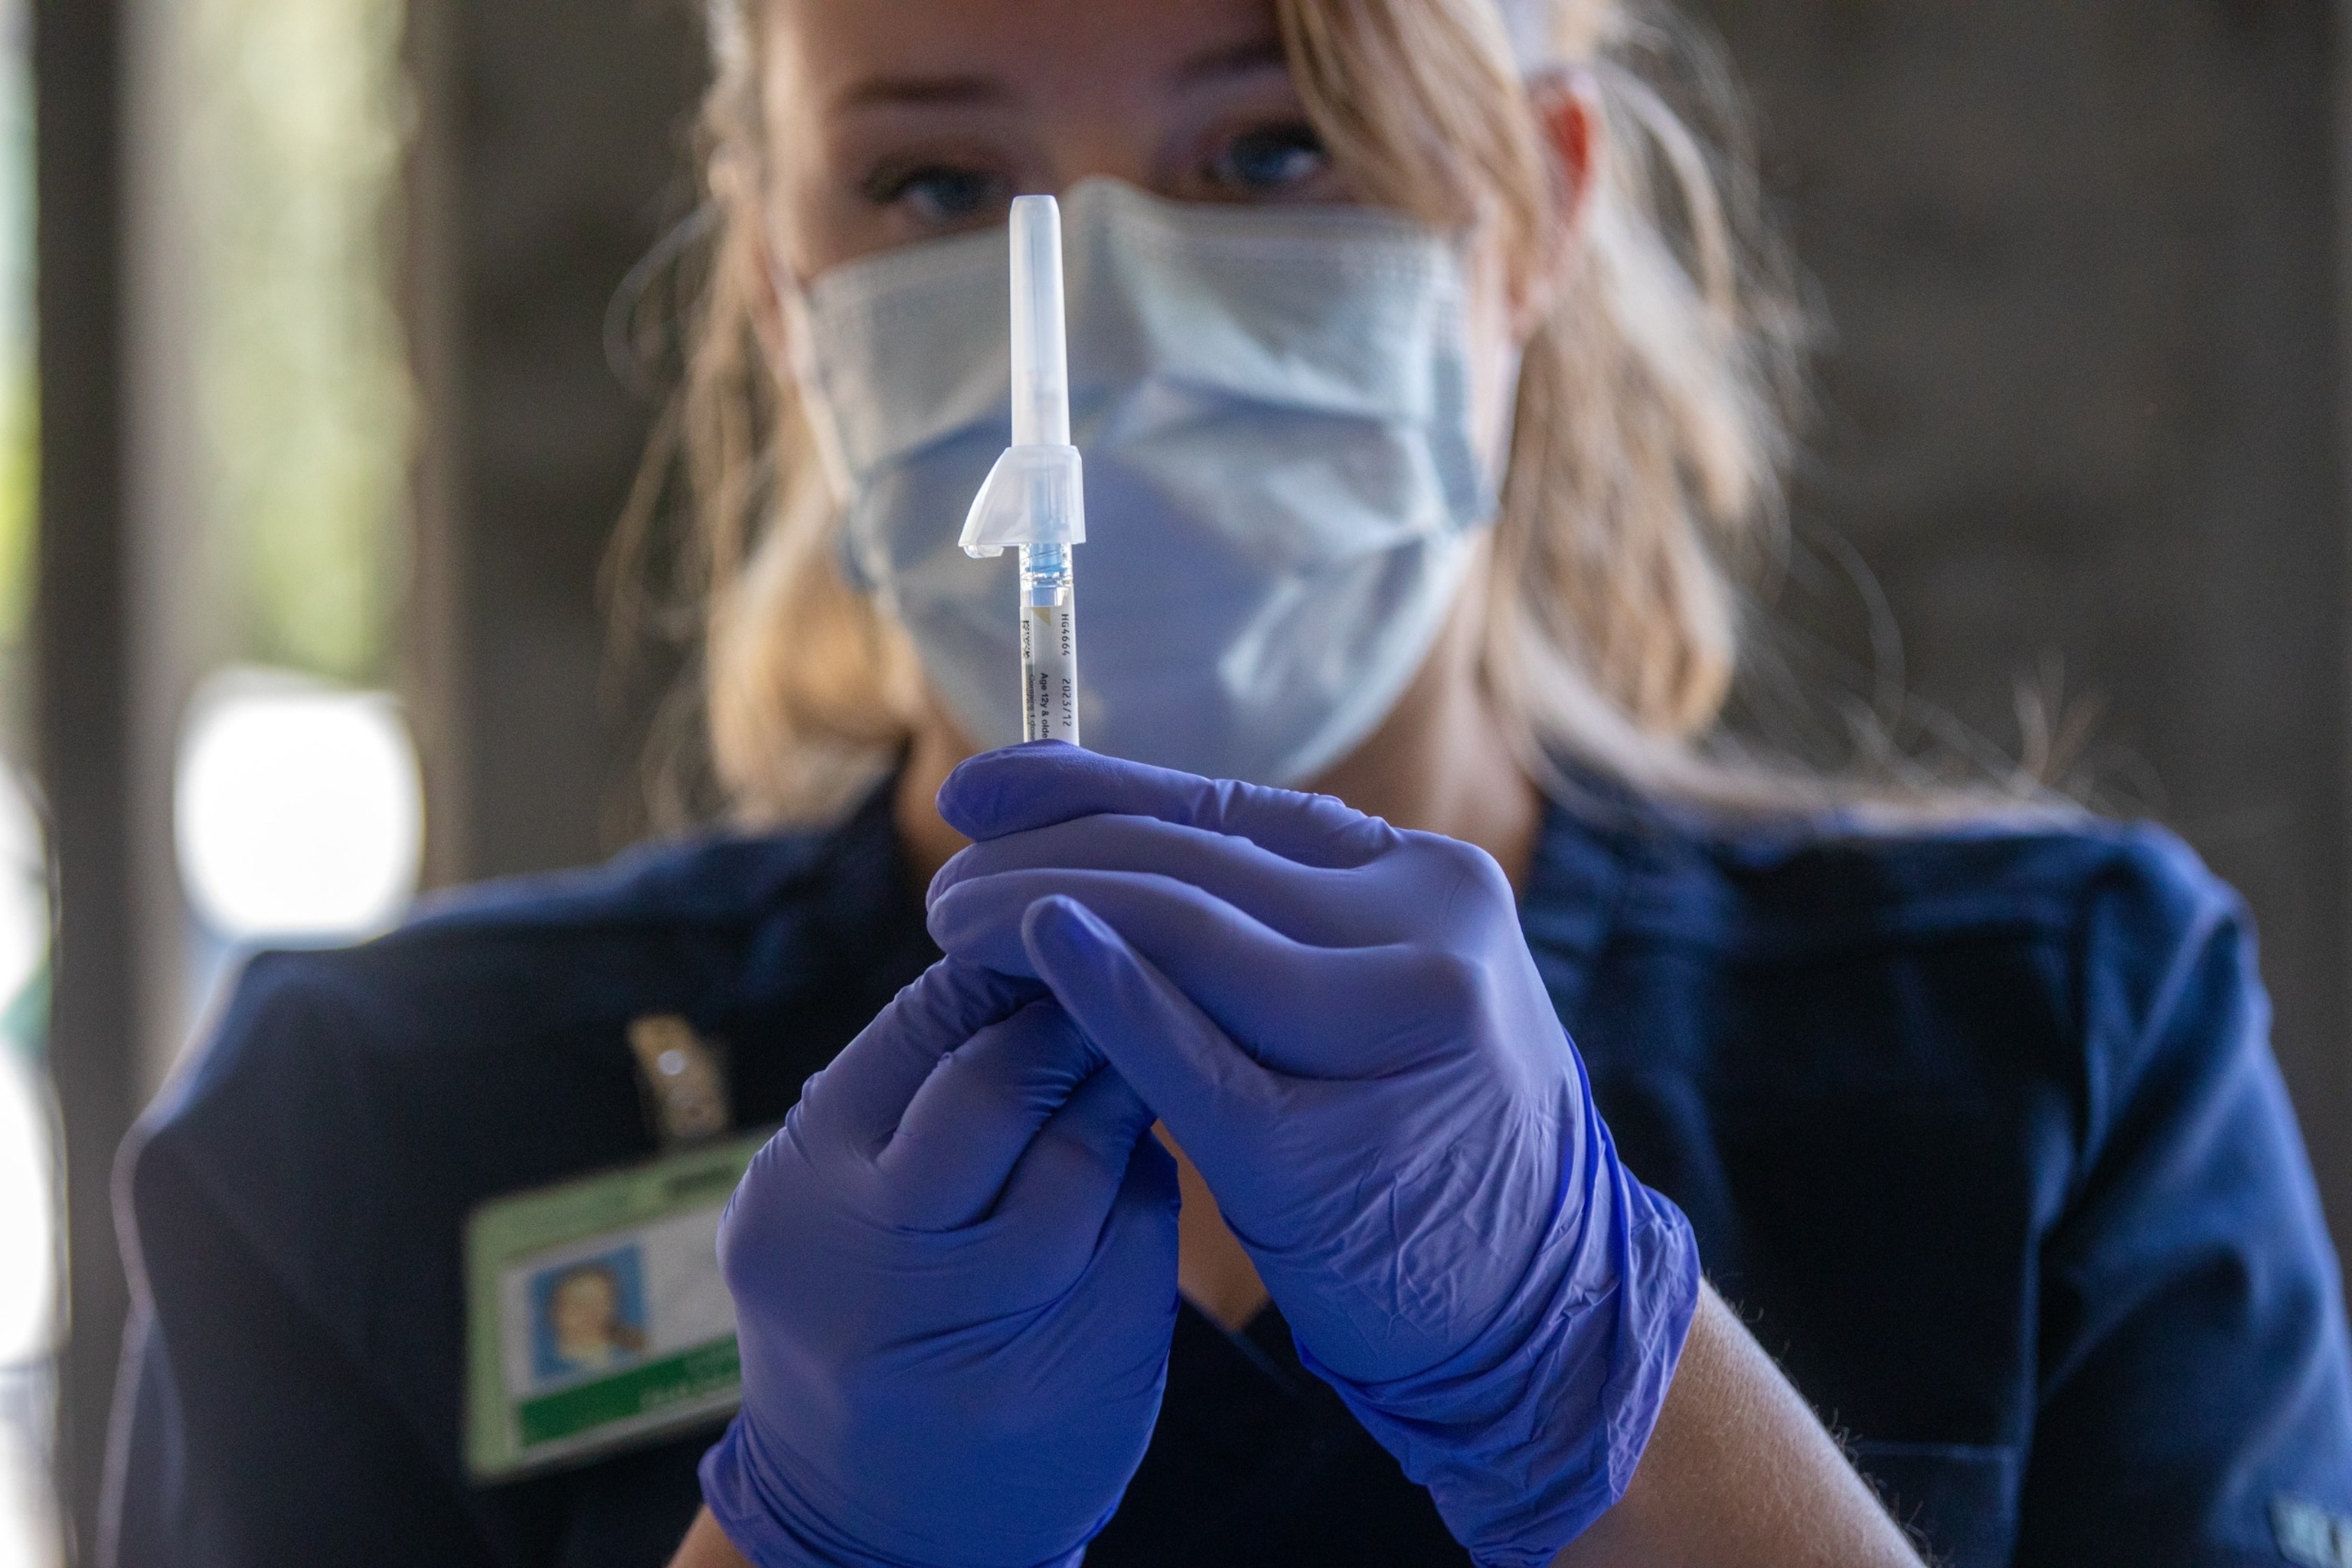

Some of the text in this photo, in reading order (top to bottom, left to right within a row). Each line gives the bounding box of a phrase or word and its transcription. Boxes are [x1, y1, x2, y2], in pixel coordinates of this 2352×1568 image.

[1061, 613, 1071, 727] HG4664 2023/12
[1039, 672, 1049, 691] Age
[1040, 693, 1049, 709] 12y
